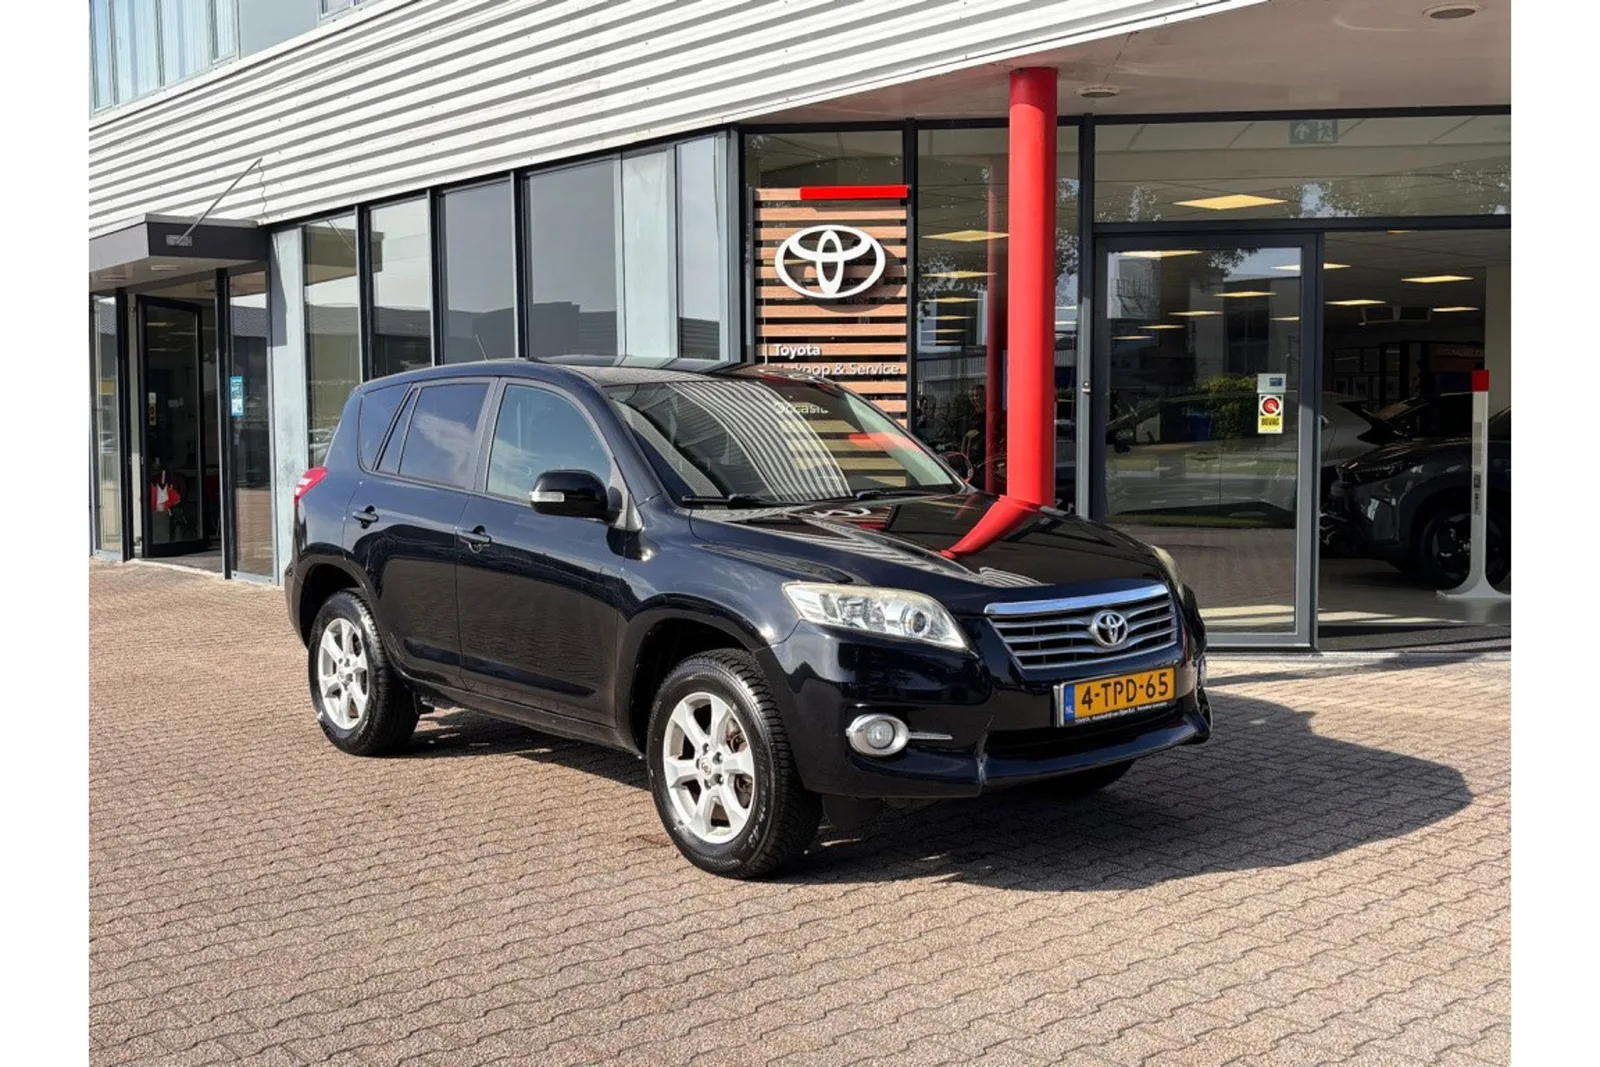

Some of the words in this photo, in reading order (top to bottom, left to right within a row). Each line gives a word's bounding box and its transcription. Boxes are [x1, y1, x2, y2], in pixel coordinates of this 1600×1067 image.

[773, 344, 821, 359] Toyota
[770, 362, 831, 379] koop
[835, 363, 848, 375] &
[850, 362, 899, 375] Service
[1081, 672, 1169, 711] 4-TPD-65
